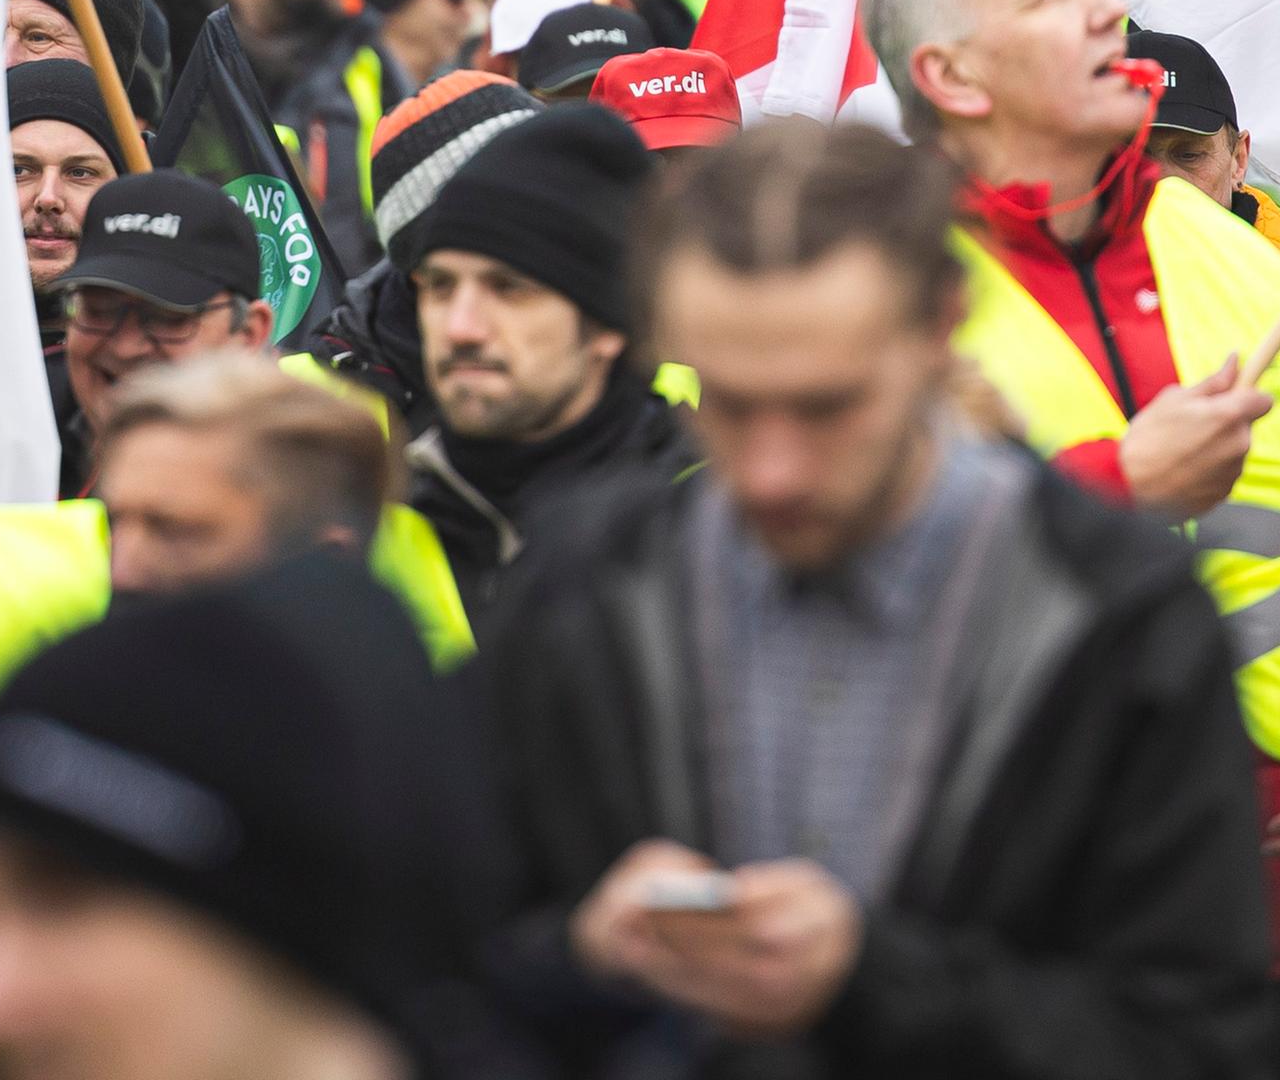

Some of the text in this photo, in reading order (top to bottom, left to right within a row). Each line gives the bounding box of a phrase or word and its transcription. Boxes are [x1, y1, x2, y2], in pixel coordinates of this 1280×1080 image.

[568, 28, 628, 47] ver.di
[628, 71, 707, 98] ver.di
[228, 184, 286, 225] AYS
[103, 212, 182, 239] ver.di
